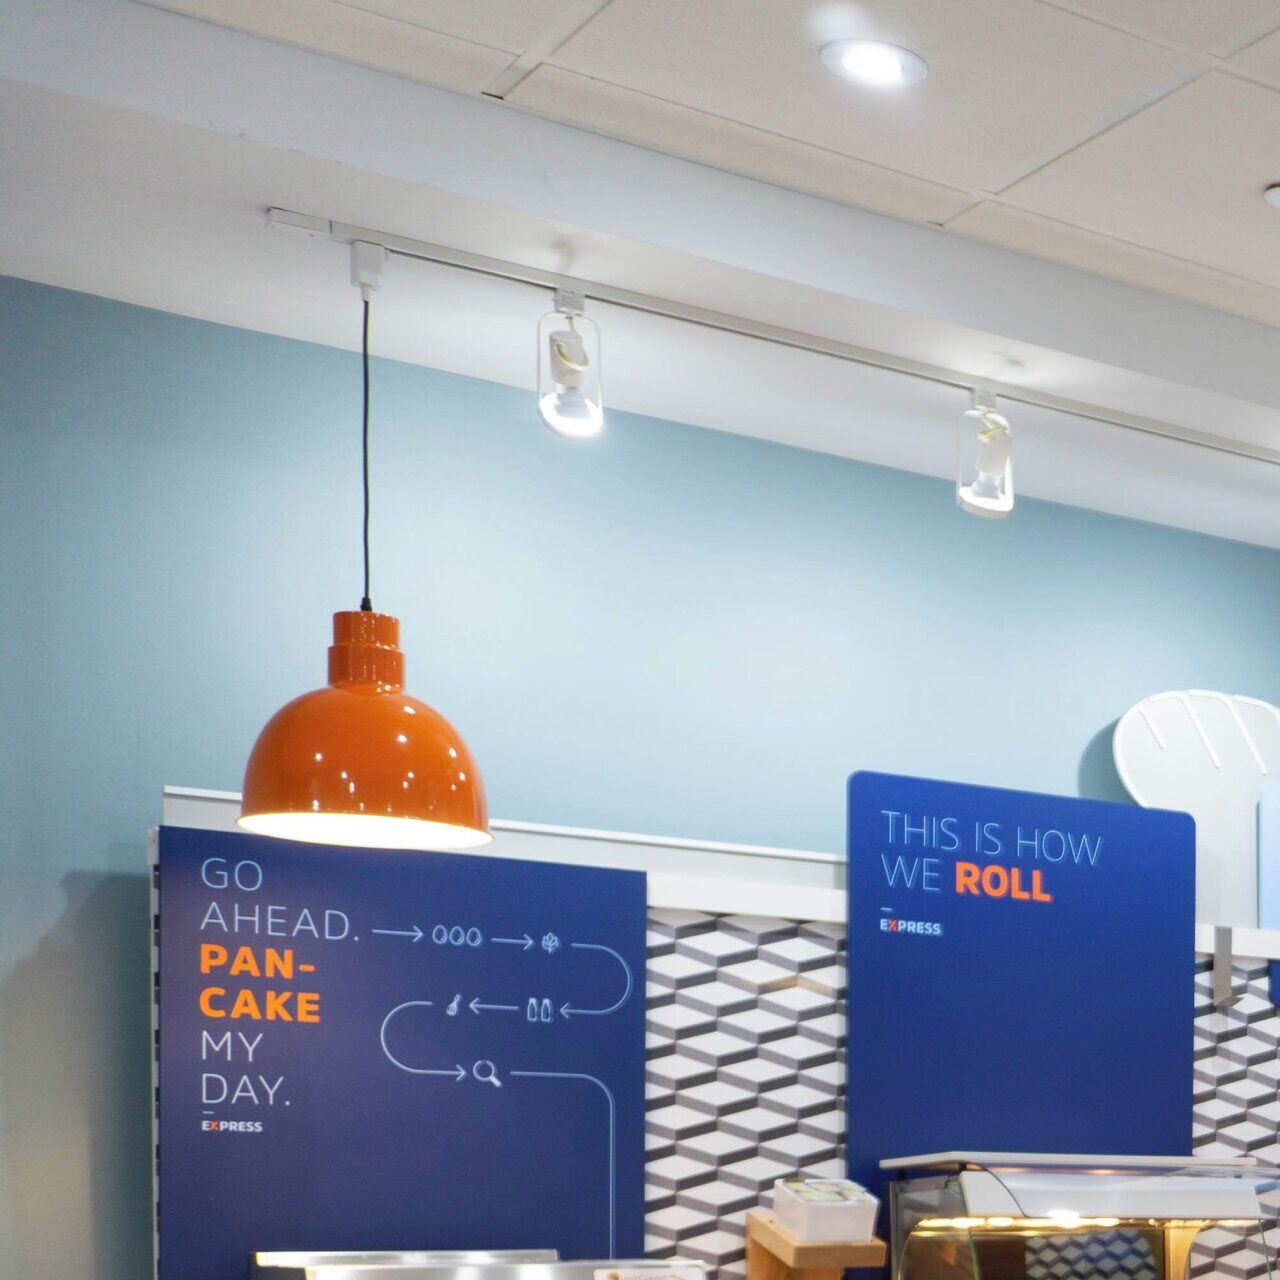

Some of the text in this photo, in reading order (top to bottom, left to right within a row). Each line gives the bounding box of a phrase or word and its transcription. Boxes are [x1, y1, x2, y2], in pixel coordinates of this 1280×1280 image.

[881, 810, 1103, 866] THIS IS HOW
[202, 858, 263, 891] GO
[881, 853, 1053, 902] WE ROLL
[200, 901, 359, 941] AHEAD.
[880, 918, 942, 936] EXPRESS
[200, 943, 317, 979] PAN-
[199, 986, 321, 1023] CAKE
[202, 1030, 264, 1062] MY
[202, 1073, 291, 1105] DAY.
[202, 1121, 263, 1132] EXPRESS
